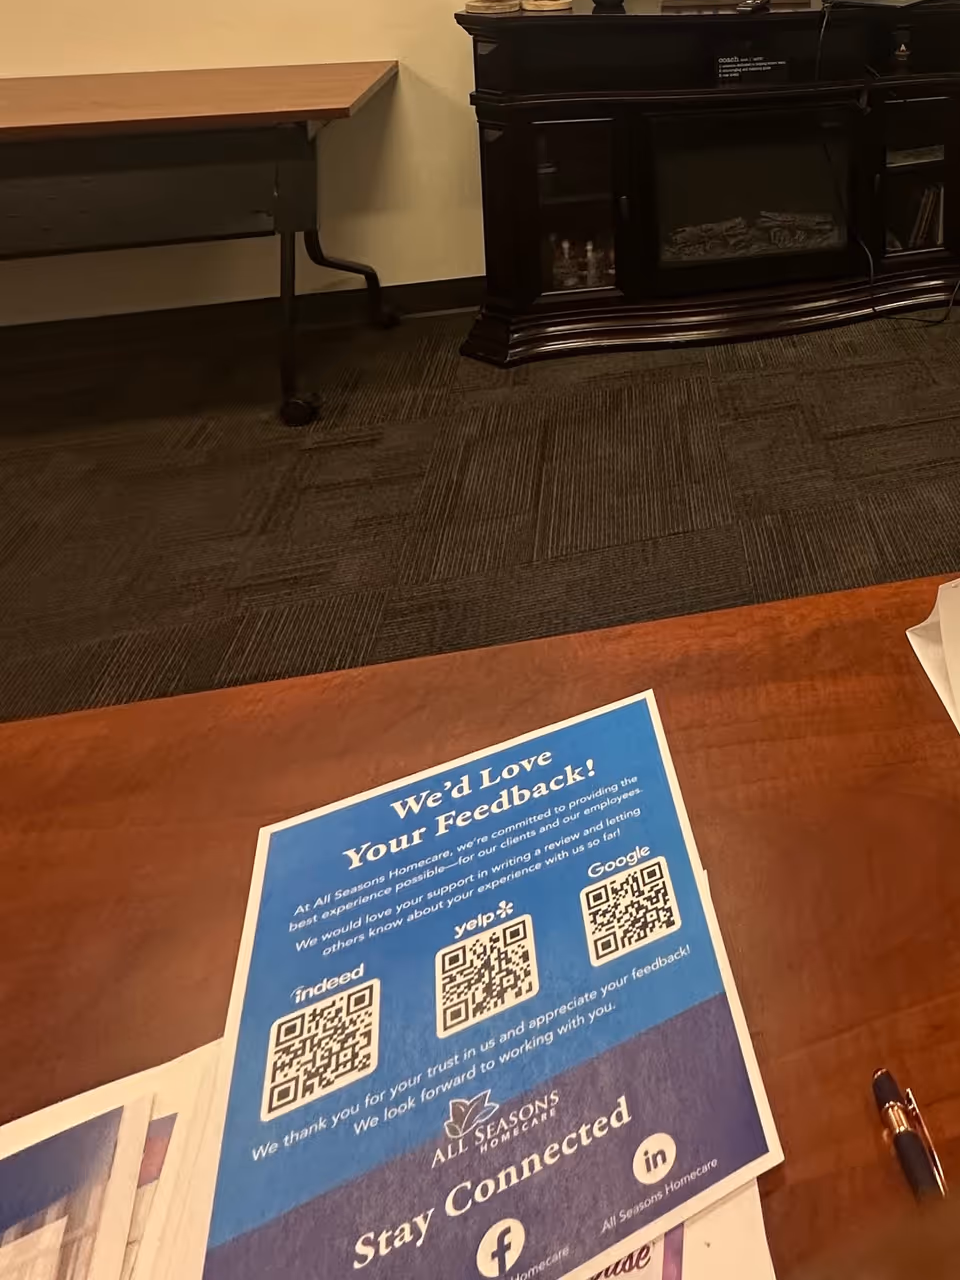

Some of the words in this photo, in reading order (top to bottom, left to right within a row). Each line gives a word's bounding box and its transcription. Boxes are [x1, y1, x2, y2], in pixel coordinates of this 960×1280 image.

[341, 827, 427, 870] Your
[434, 759, 596, 837] Feedback!
[479, 751, 553, 790] Love
[289, 914, 319, 933] best
[321, 886, 393, 923] experience
[477, 845, 497, 858] our
[500, 829, 537, 850] clients
[539, 820, 560, 835] and
[562, 812, 581, 825] our
[583, 788, 644, 817] employees.
[293, 904, 311, 917] At
[313, 894, 332, 910] All
[334, 875, 385, 901] Seasons
[388, 849, 453, 880] Homecare,
[491, 809, 551, 839] committed
[554, 804, 566, 815] to
[568, 783, 619, 811] providing
[620, 775, 638, 789] the
[295, 937, 318, 952] We
[321, 919, 363, 942] would
[365, 907, 393, 924] love
[395, 895, 424, 914] your
[427, 875, 475, 901] support
[477, 869, 488, 880] in
[491, 851, 531, 874] writing
[534, 848, 542, 858] a
[544, 832, 580, 852] review
[583, 822, 604, 837] and
[605, 806, 641, 828] letting
[322, 933, 366, 957] others
[368, 919, 404, 938] know
[407, 900, 444, 923] about
[446, 889, 475, 909] your
[477, 863, 542, 895] experience
[544, 850, 569, 866] with
[571, 845, 586, 856] us
[587, 838, 601, 849] so
[603, 829, 621, 843] far!
[587, 845, 651, 878] Google
[454, 908, 495, 939] yelp
[293, 962, 365, 1004] indeed
[251, 1141, 278, 1162] We
[282, 1117, 328, 1148] thank
[331, 1104, 361, 1130] you
[364, 1089, 387, 1109] for
[389, 1072, 424, 1101] your
[427, 1053, 460, 1078] trust
[462, 1047, 476, 1062] in
[480, 1037, 496, 1053] us
[499, 1022, 526, 1043] and
[528, 989, 598, 1031] appreciate
[600, 974, 629, 999] your
[631, 944, 691, 980] feedback!
[353, 1117, 380, 1136] We
[384, 1096, 417, 1120] look
[420, 1066, 477, 1103] forward
[480, 1060, 496, 1074] to
[499, 1030, 554, 1065] working
[556, 1013, 586, 1036] with
[588, 1004, 617, 1025] you.
[352, 1207, 435, 1271] Stay
[444, 1095, 633, 1218] Connected
[431, 1138, 469, 1169] ALL
[474, 1089, 560, 1146] SEASONS
[480, 1108, 557, 1154] HOMECARE
[600, 1215, 617, 1234] All
[618, 1192, 664, 1222] Seasons
[665, 1158, 719, 1195] Homecare
